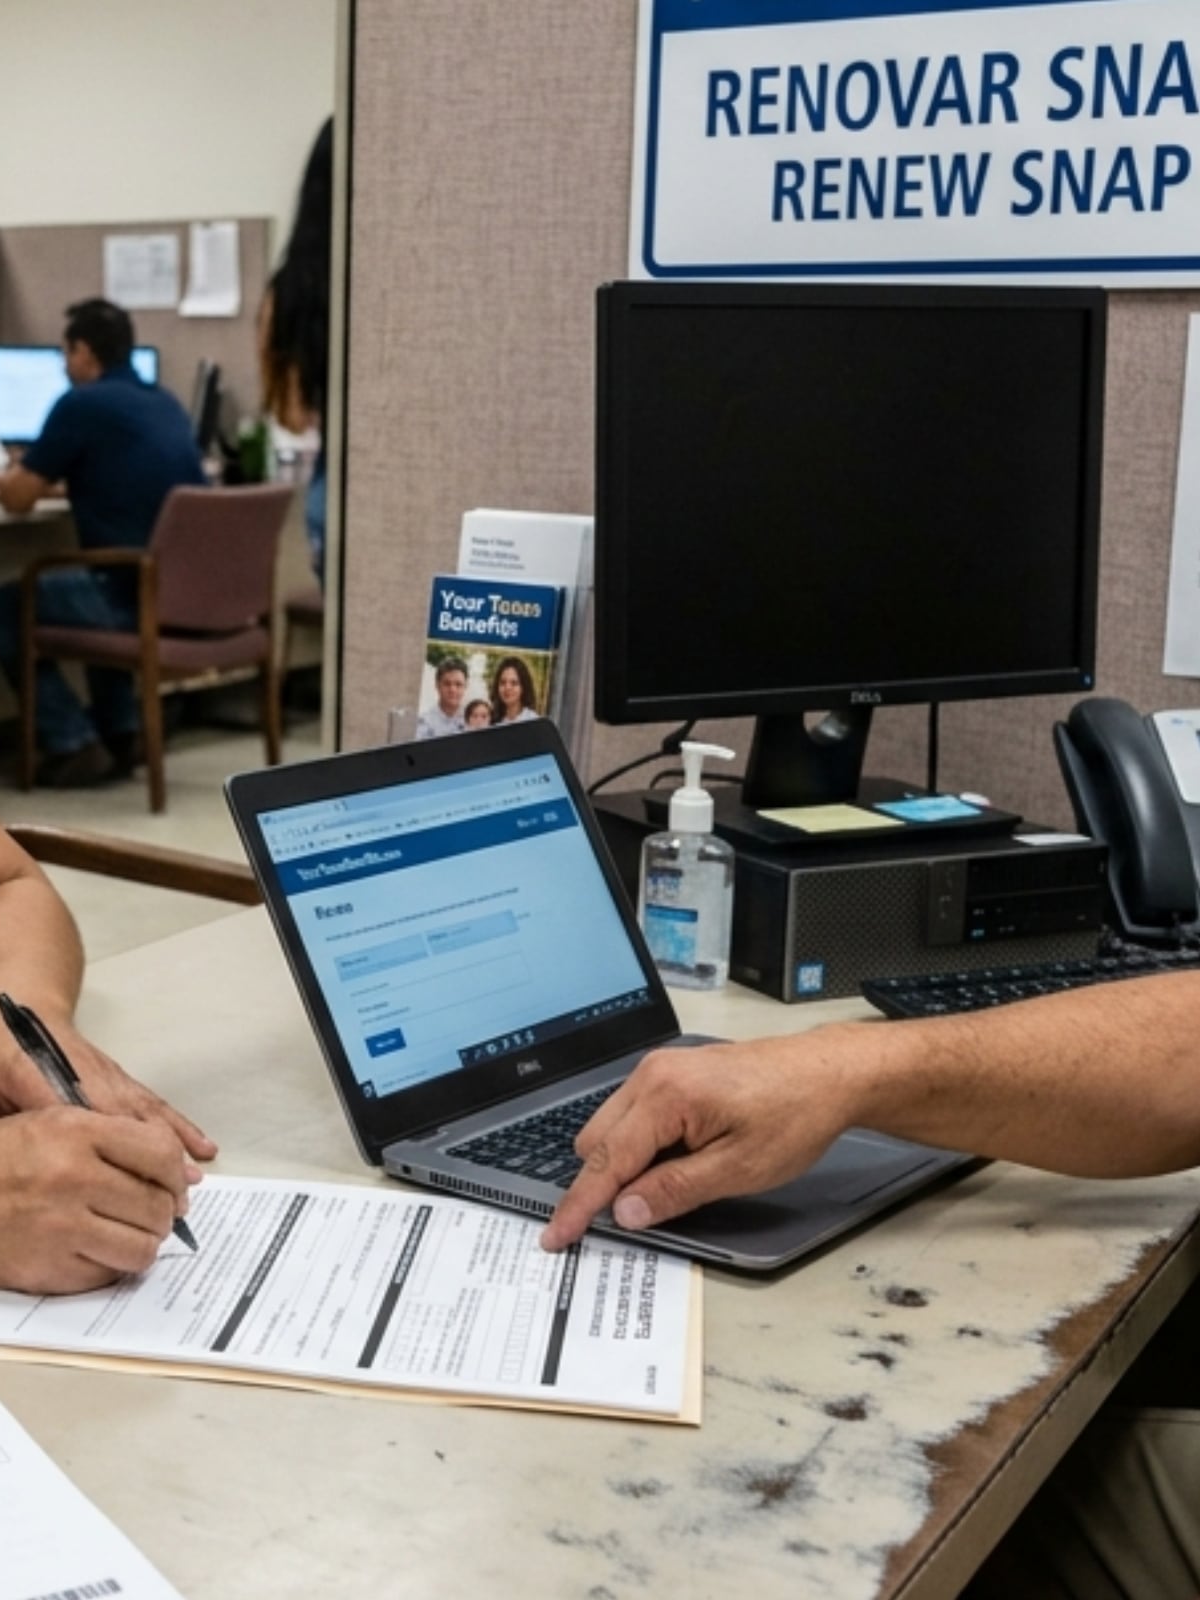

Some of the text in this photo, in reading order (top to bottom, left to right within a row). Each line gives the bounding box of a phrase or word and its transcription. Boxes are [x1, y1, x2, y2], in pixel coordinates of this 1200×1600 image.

[706, 52, 1019, 137] RENOVAR
[772, 145, 1191, 221] RENEW SNAP
